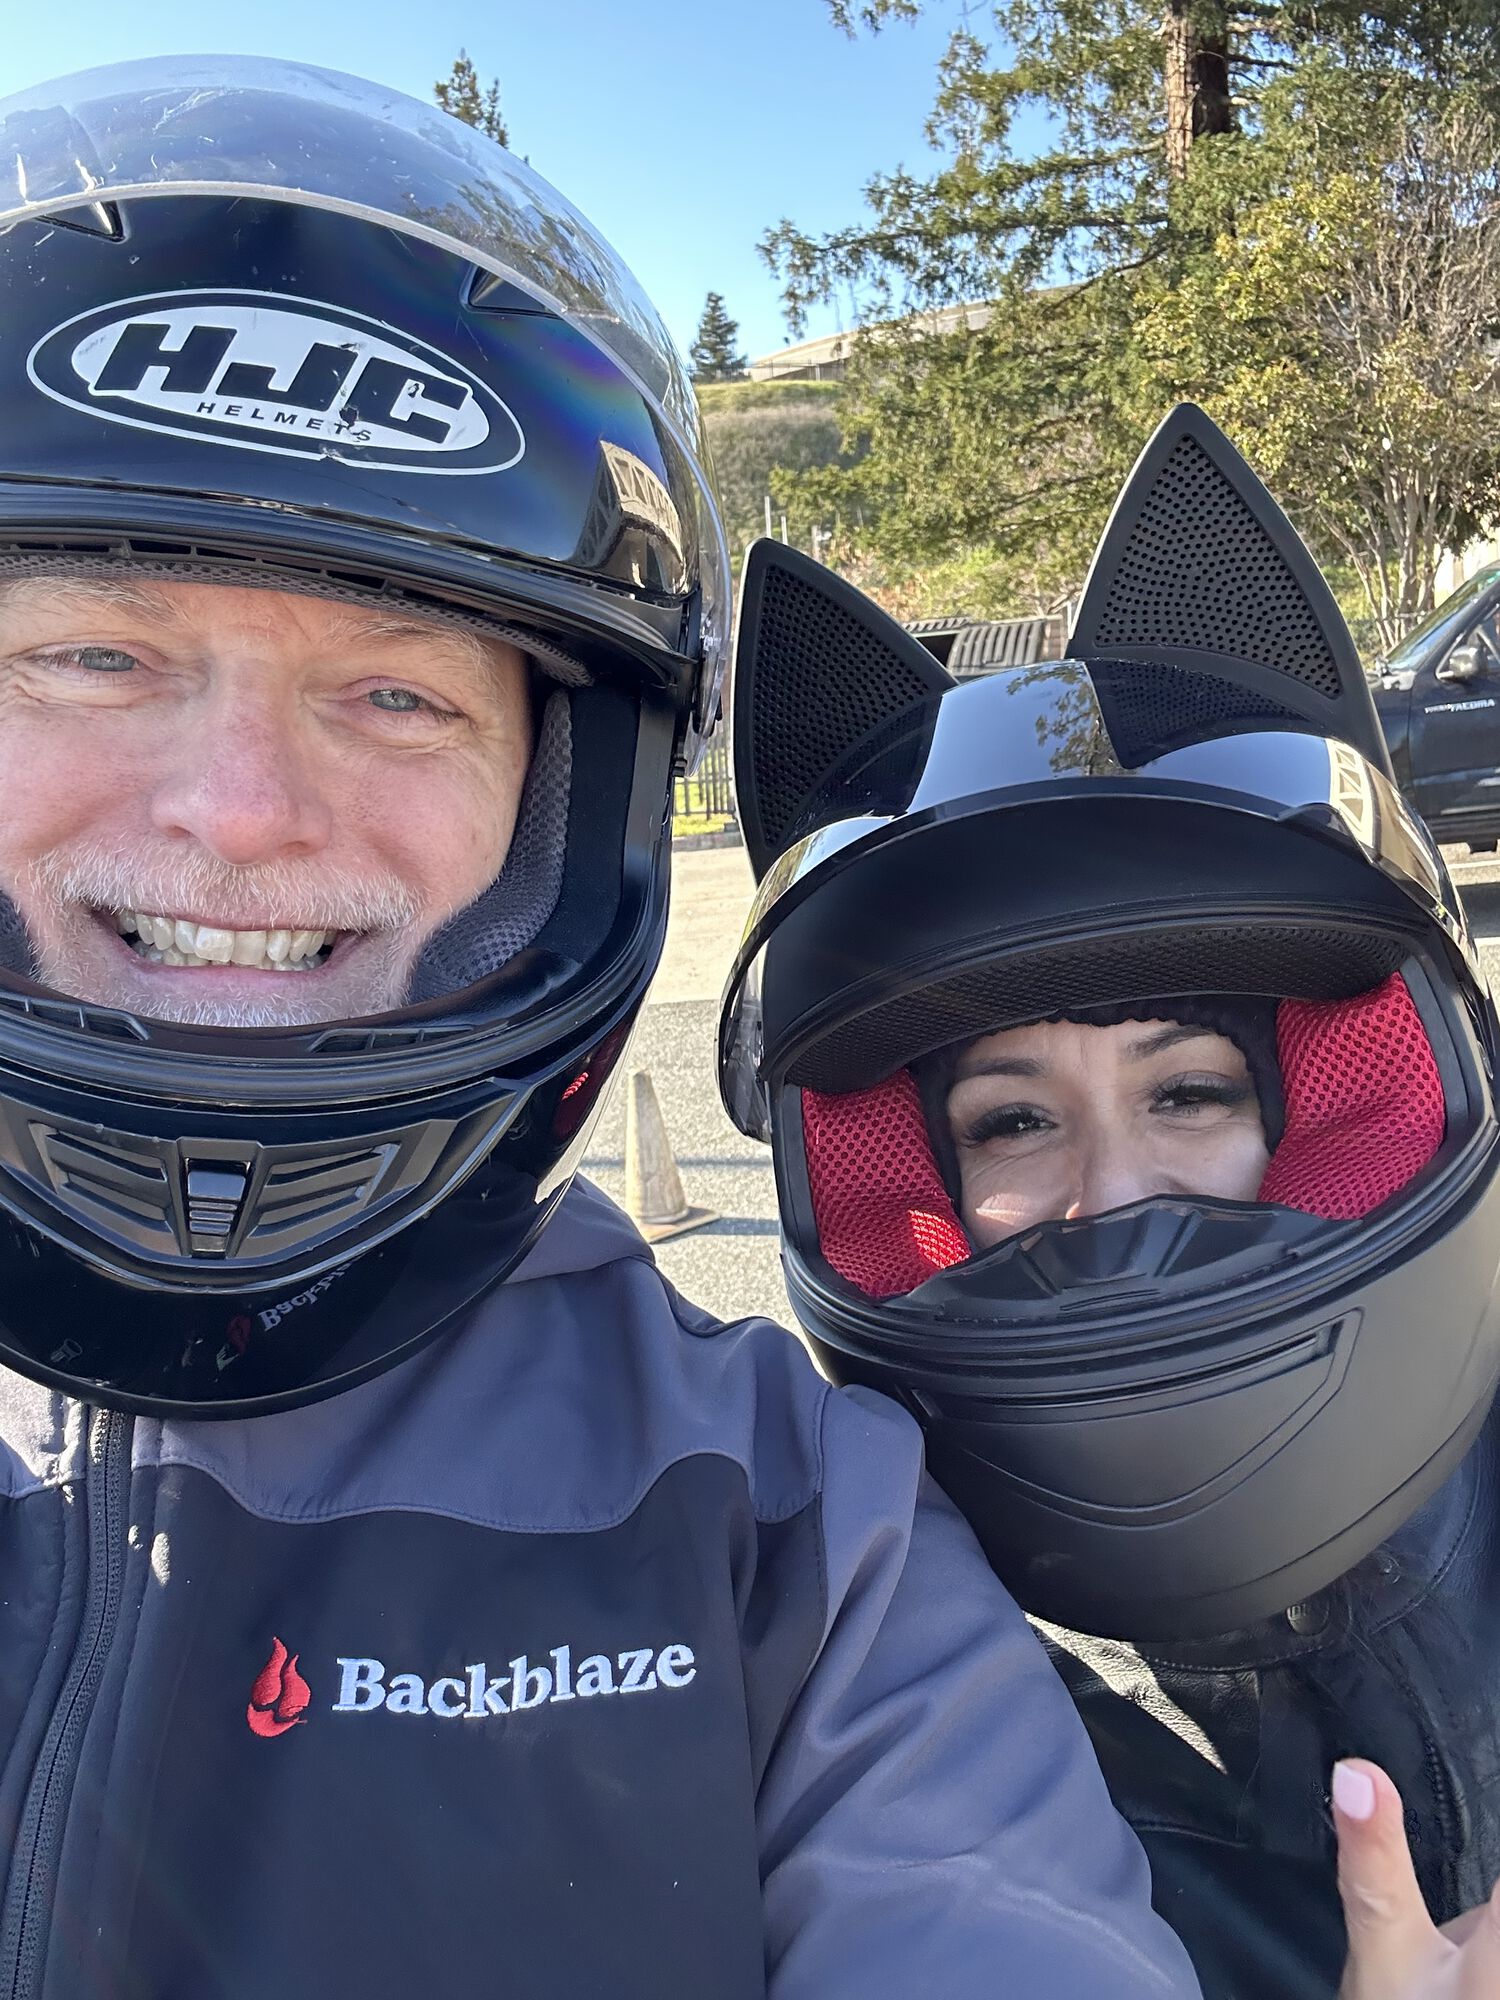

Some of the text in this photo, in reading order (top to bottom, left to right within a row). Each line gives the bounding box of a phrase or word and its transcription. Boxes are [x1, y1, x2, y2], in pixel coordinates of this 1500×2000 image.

[94, 323, 468, 444] HJC
[195, 402, 372, 441] HELMETS
[331, 1643, 697, 1719] Backblaze
